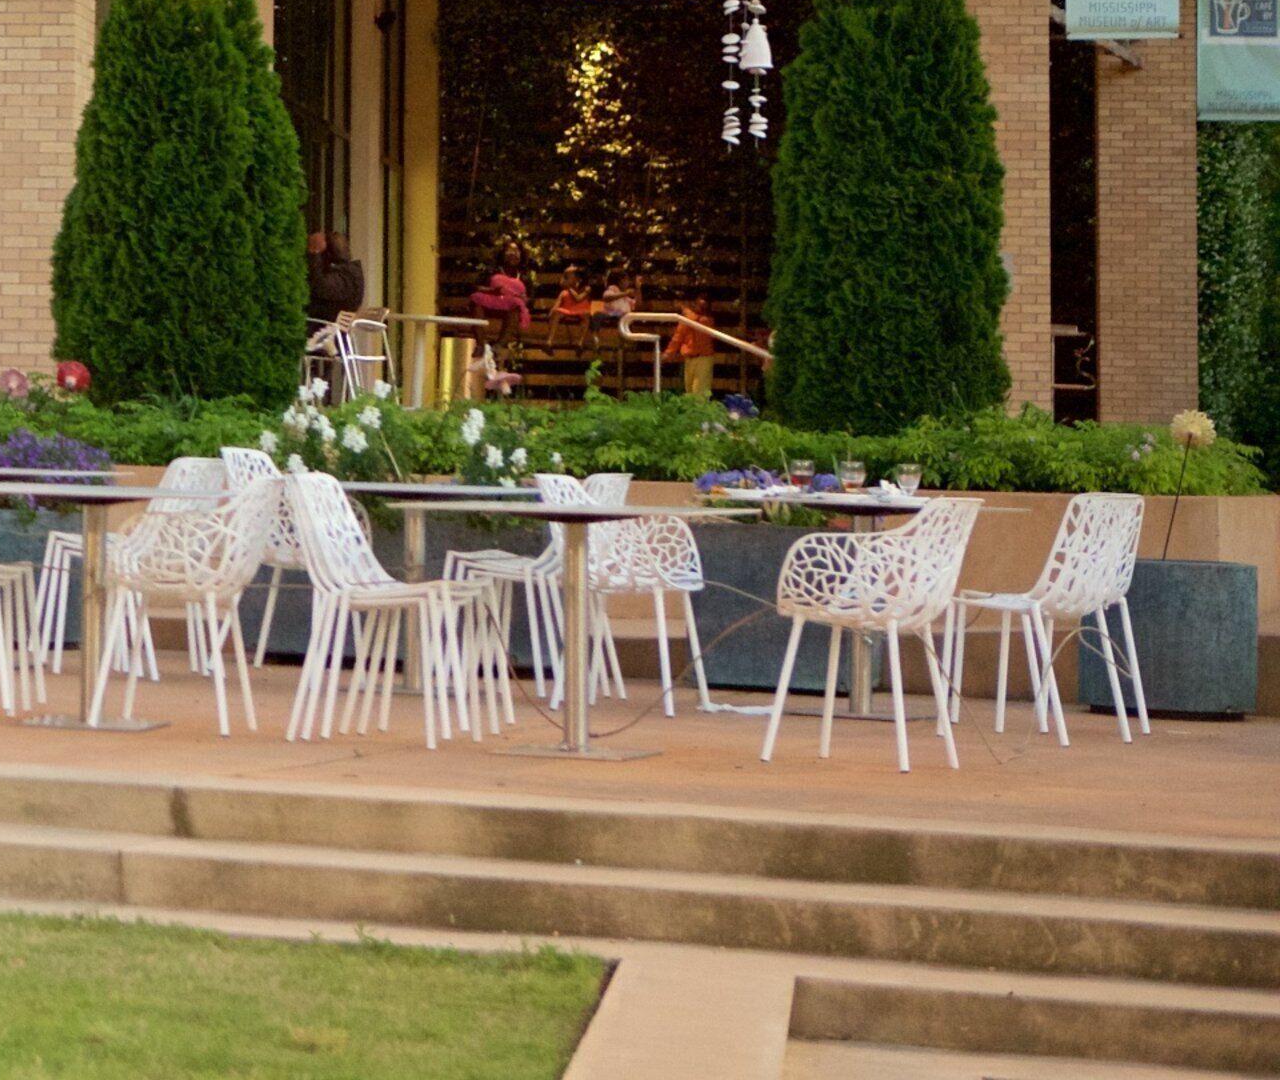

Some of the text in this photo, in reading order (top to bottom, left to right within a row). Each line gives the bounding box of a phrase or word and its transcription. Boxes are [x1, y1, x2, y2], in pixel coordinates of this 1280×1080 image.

[1088, 0, 1157, 14] MISSISSIPPI
[1078, 16, 1127, 28] MUSEUM
[1146, 15, 1168, 27] ART
